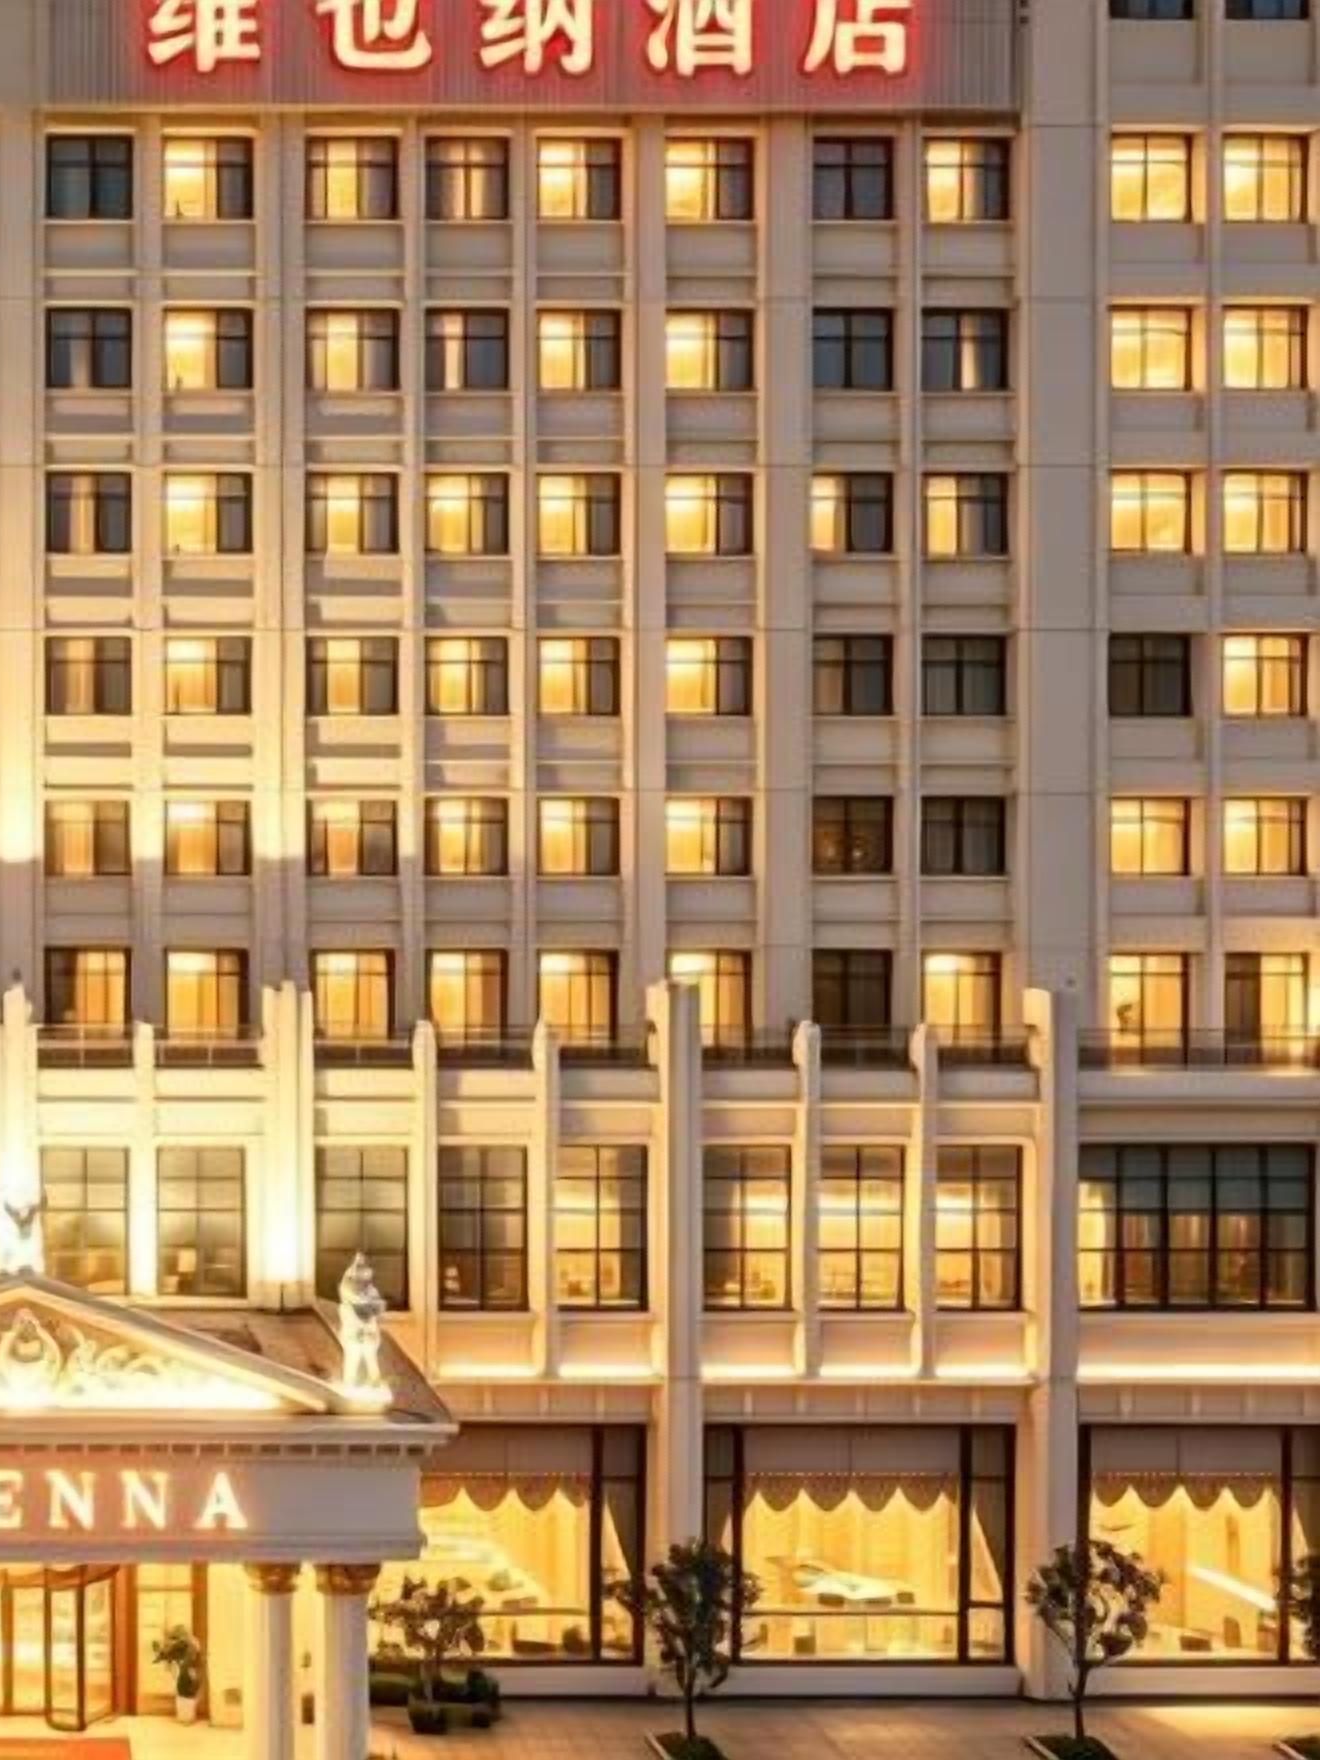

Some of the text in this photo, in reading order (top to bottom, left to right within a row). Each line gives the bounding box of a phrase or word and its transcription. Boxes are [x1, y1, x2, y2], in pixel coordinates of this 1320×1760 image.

[148, 0, 912, 75] 维也纳酒店
